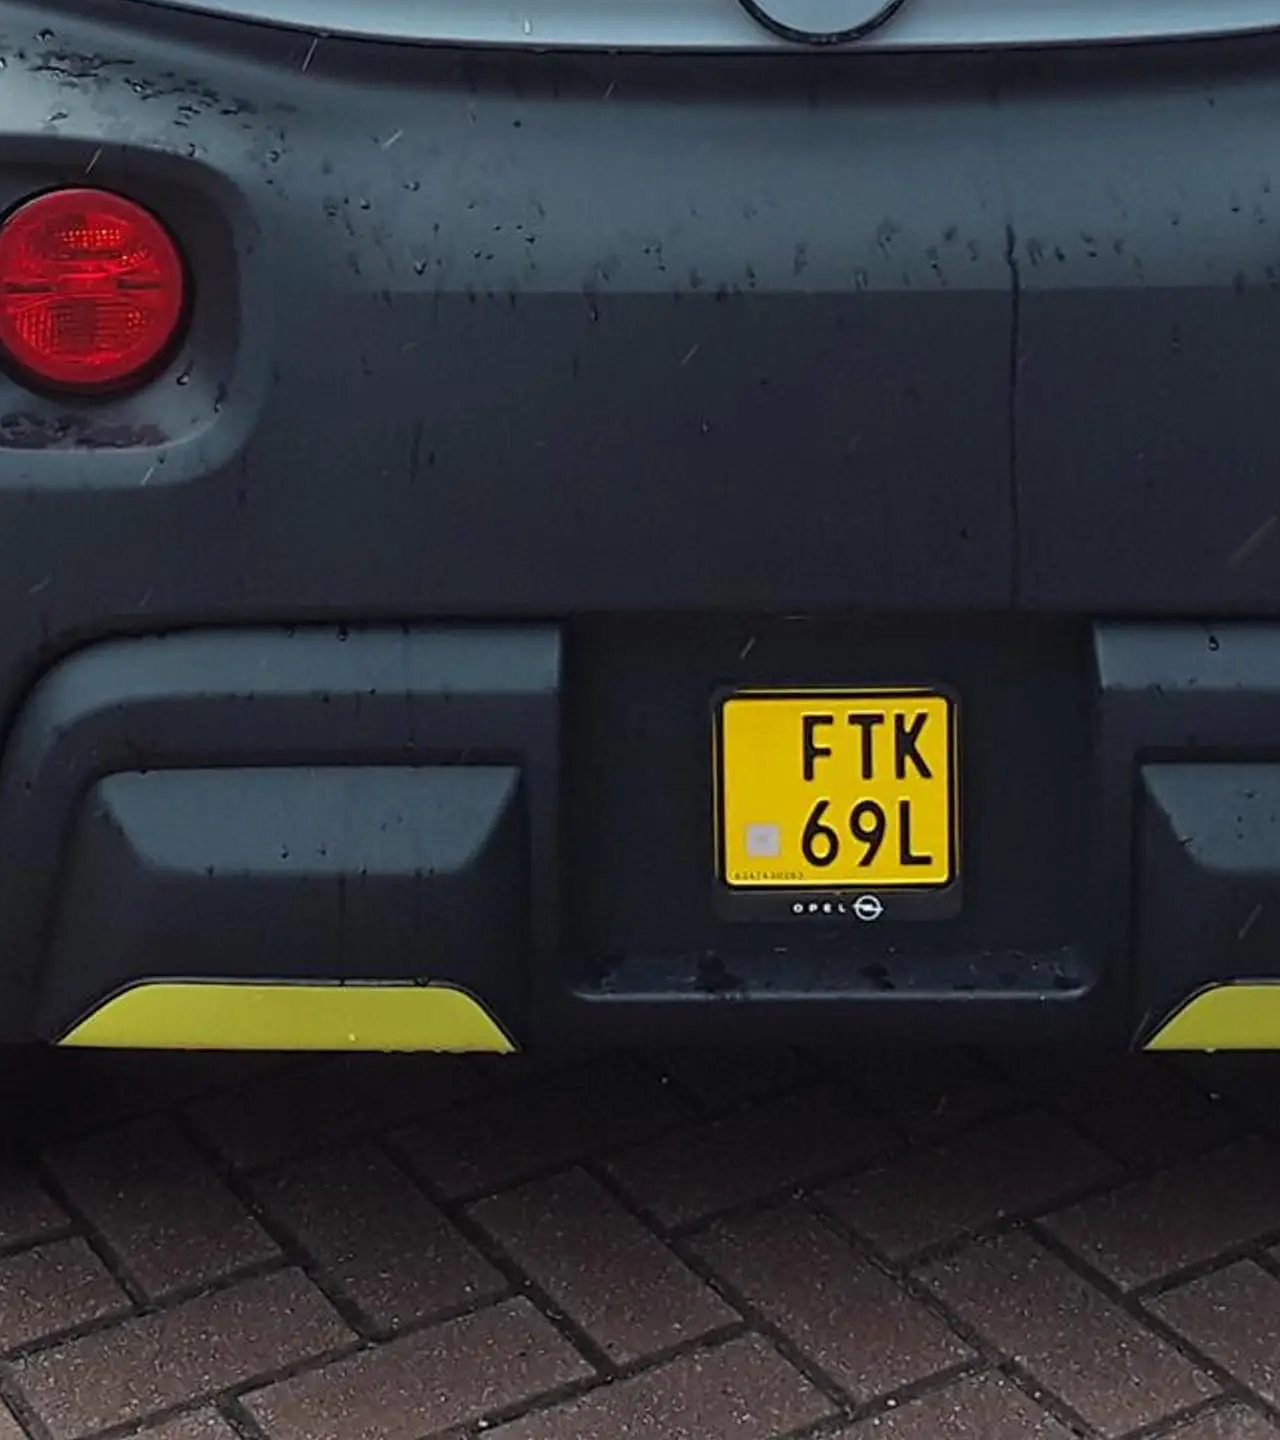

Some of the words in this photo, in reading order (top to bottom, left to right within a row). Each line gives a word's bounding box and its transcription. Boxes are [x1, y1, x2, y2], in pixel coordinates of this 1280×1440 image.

[803, 712, 933, 781] FTK
[801, 798, 934, 868] 69L
[792, 902, 846, 914] OPEL
